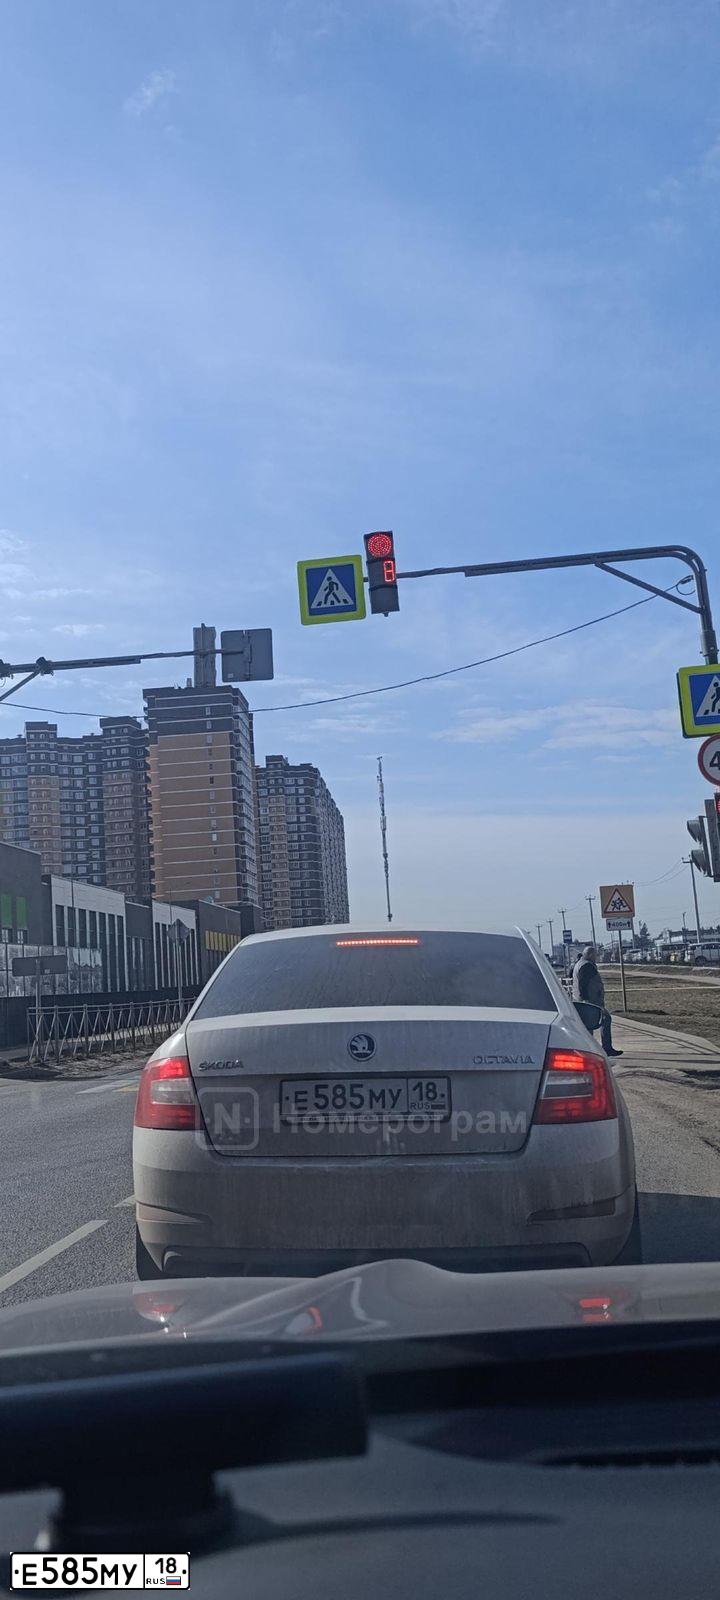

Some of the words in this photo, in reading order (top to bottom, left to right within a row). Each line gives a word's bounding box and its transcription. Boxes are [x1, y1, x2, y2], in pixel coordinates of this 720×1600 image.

[473, 1055, 535, 1065] OCTAVIA
[412, 1081, 438, 1101] 18
[410, 1102, 431, 1110] RUS
